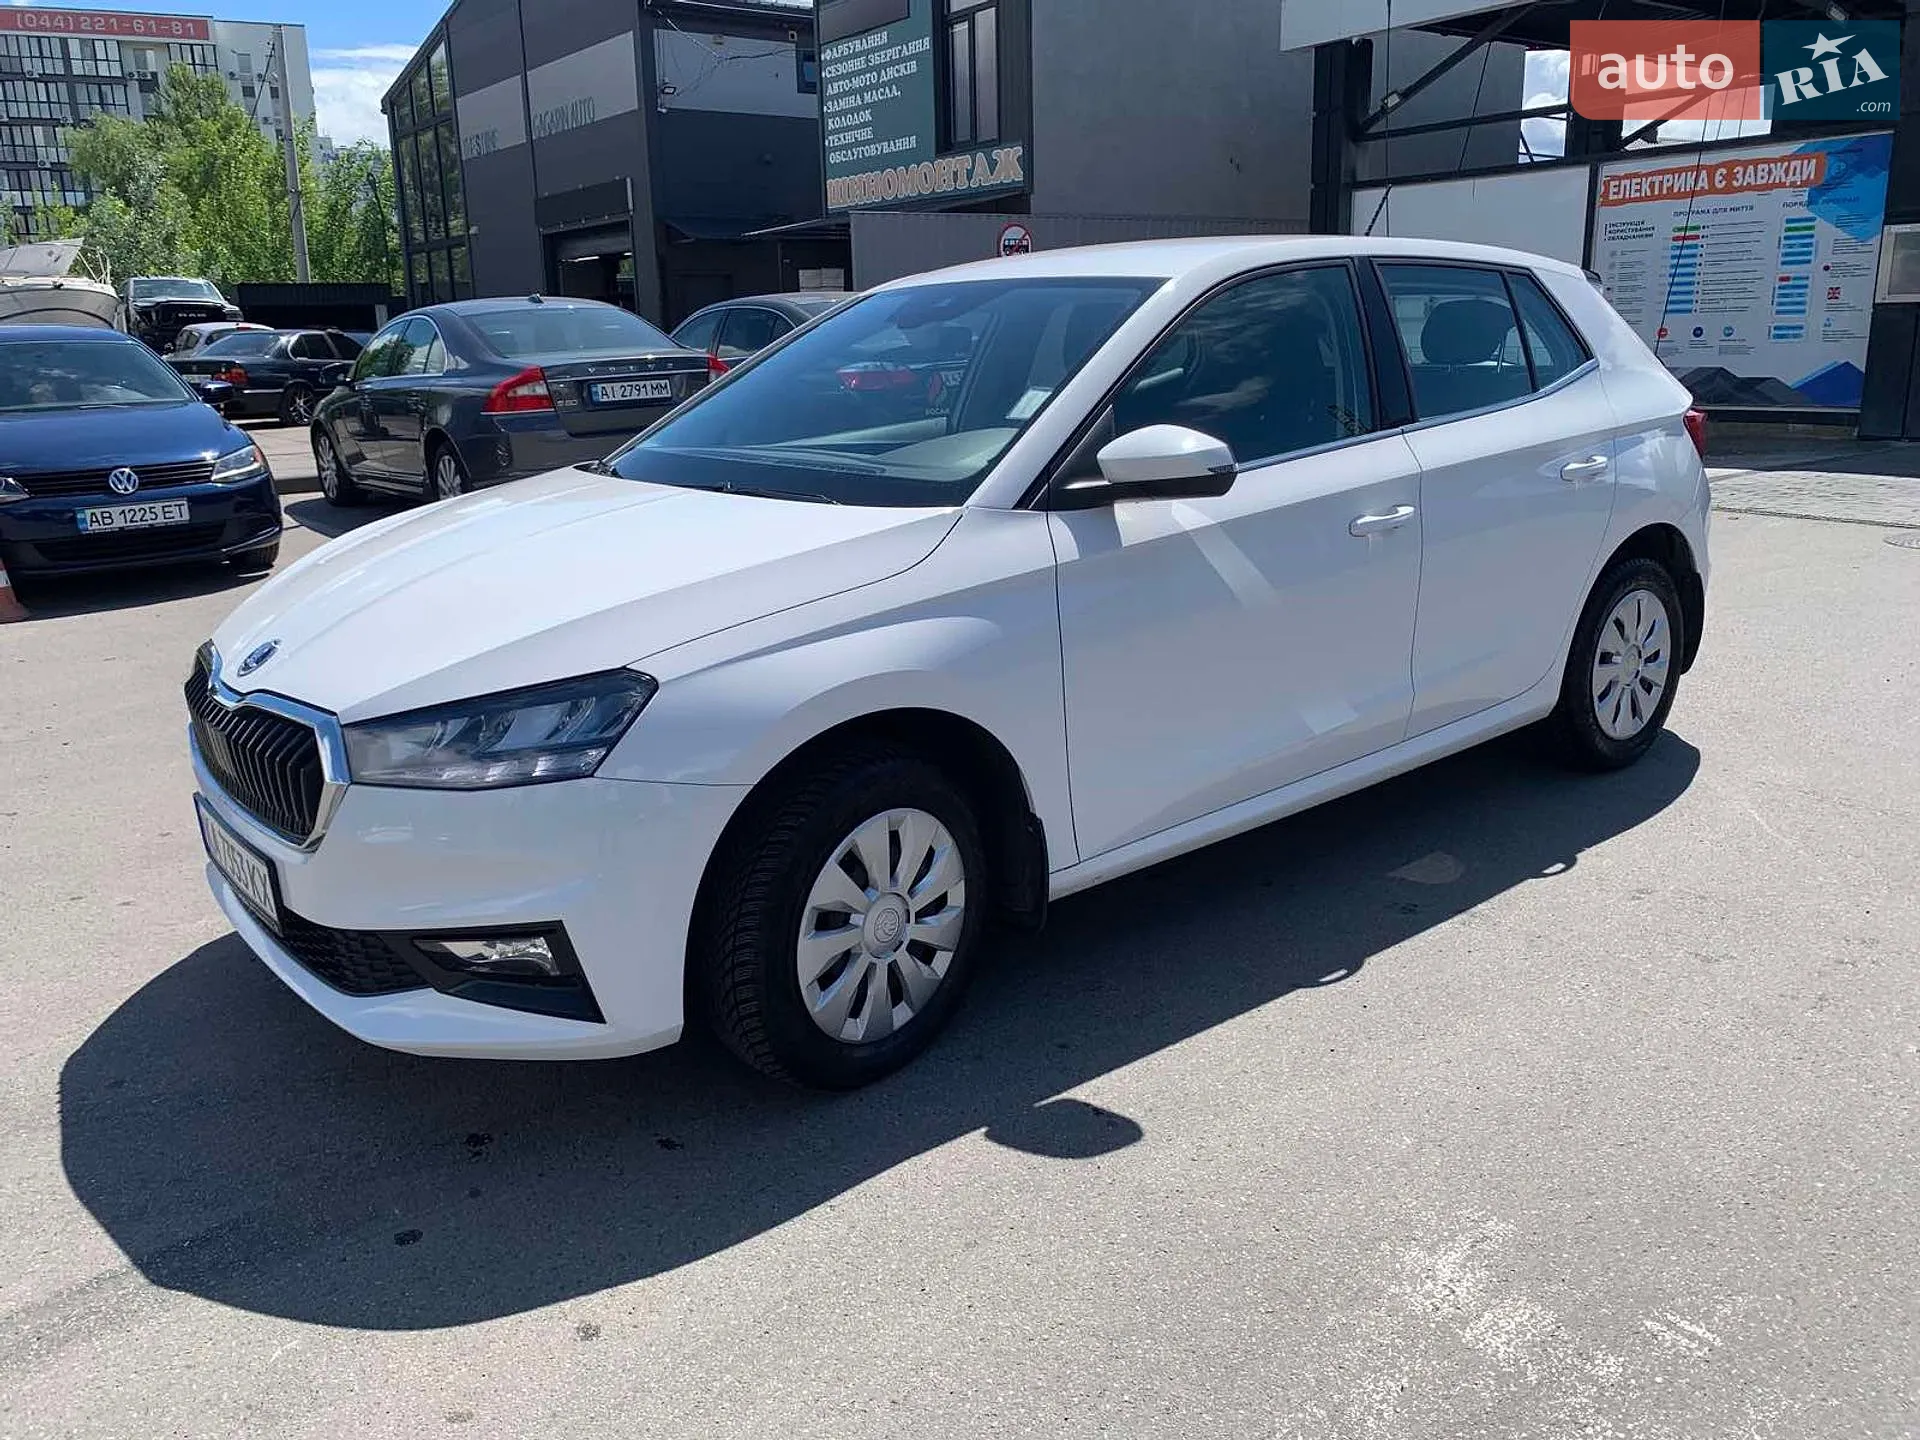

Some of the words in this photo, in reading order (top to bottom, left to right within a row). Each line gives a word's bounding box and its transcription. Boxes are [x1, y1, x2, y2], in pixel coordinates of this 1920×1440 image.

[16, 12, 73, 30] (044)
[80, 15, 194, 35] 221-61-81
[825, 31, 888, 61] ФАРБУВАННЯ
[826, 56, 867, 78] СЕЗОННЕ
[868, 37, 930, 66] ЗБЕРІГАННЯ
[879, 61, 917, 83] ДИСКІВ
[827, 92, 862, 112] ЗАМІНА
[828, 109, 873, 131] КОЛОДОК
[829, 127, 874, 147] ТЕХНІЧНЕ
[829, 135, 917, 164] ОБСЛУГОВУВАННЯ
[827, 147, 1023, 208] ШИНОМОНТАЖ
[1609, 166, 1709, 199] ЕЛЕКТРИКА
[1714, 167, 1727, 188] Є
[1733, 158, 1816, 186] ЗАВЖДИ
[601, 385, 616, 400] AI
[620, 383, 648, 398] 2791
[651, 382, 669, 397] MM
[89, 511, 114, 528] AB
[119, 506, 159, 525] 1225
[161, 503, 185, 520] ET
